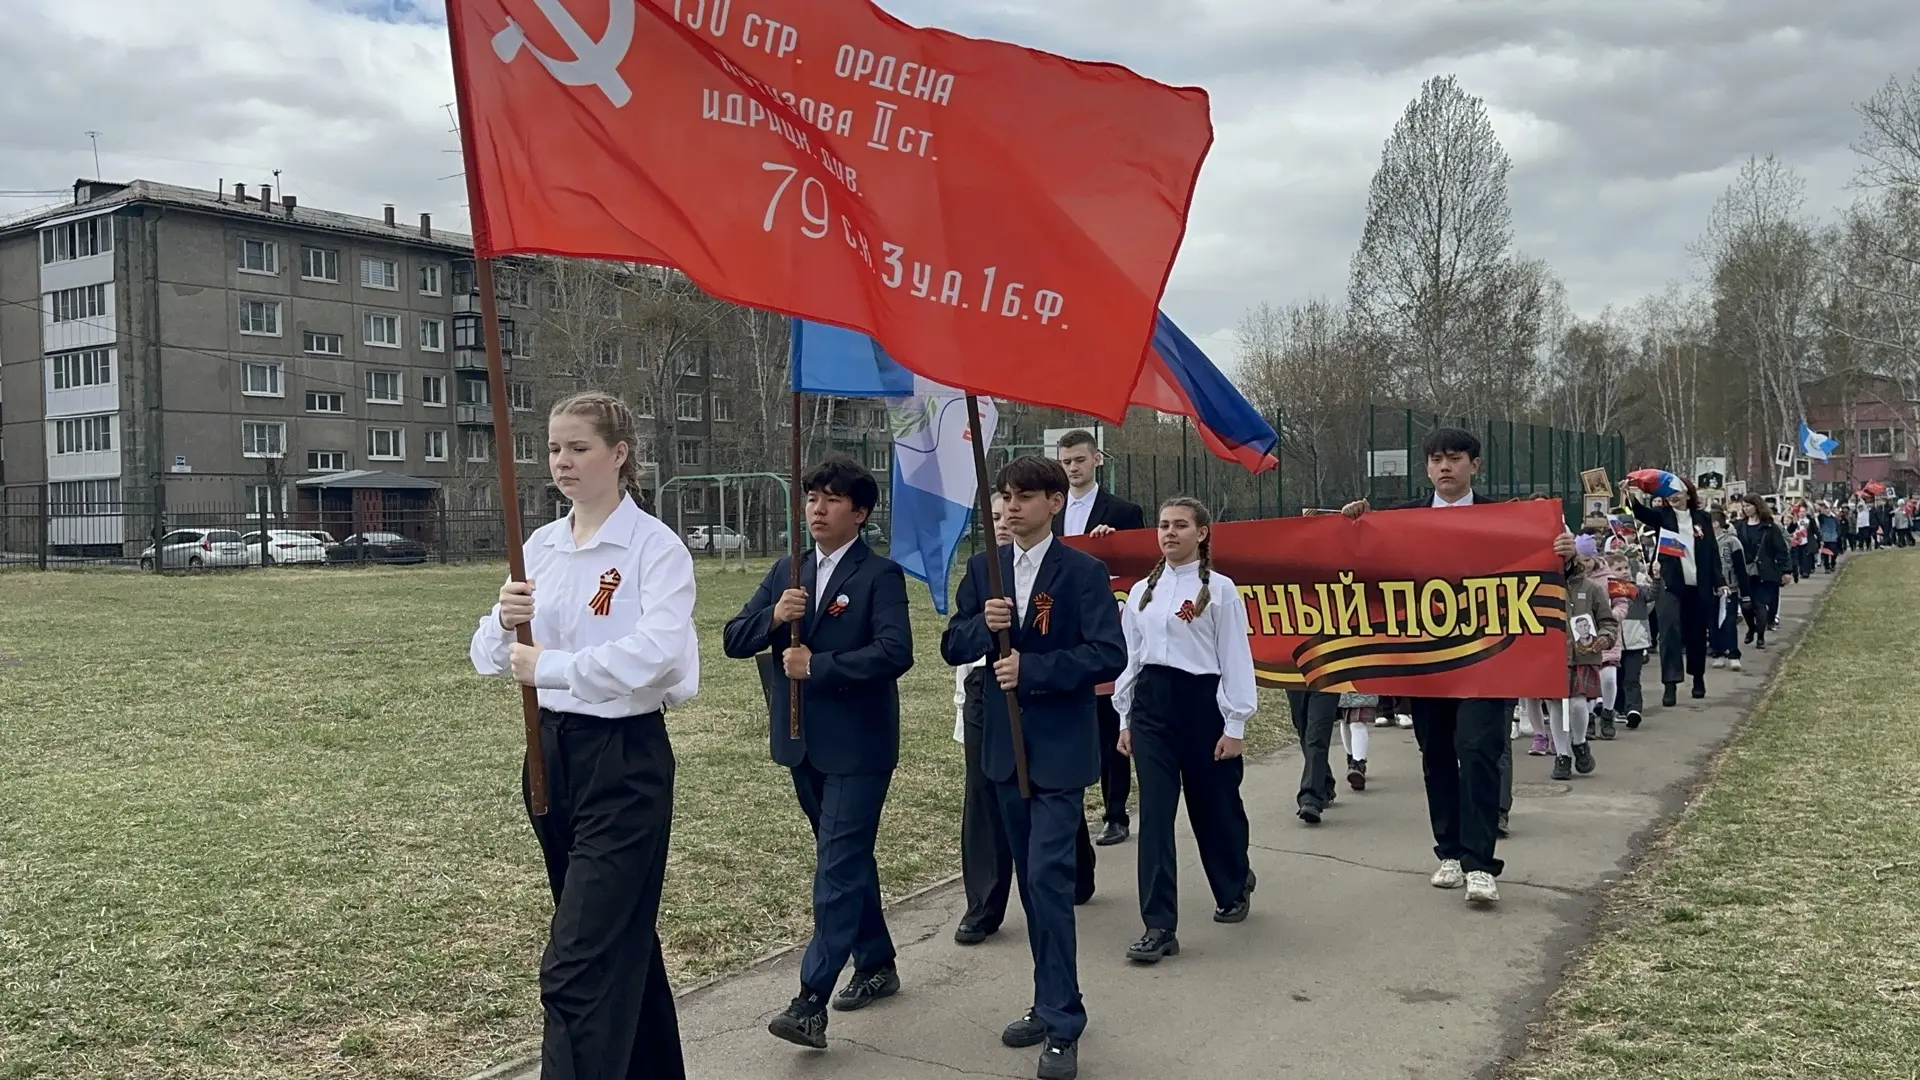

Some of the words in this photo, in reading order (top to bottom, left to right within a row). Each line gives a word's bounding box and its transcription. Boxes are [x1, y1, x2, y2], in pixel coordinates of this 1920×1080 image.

[742, 13, 803, 65] СТР.
[835, 44, 955, 107] ОРДЕНА
[820, 146, 863, 197] ДИВ.
[897, 126, 938, 161] СТ.
[761, 161, 829, 239] 79
[1378, 575, 1545, 638] ПОЛК
